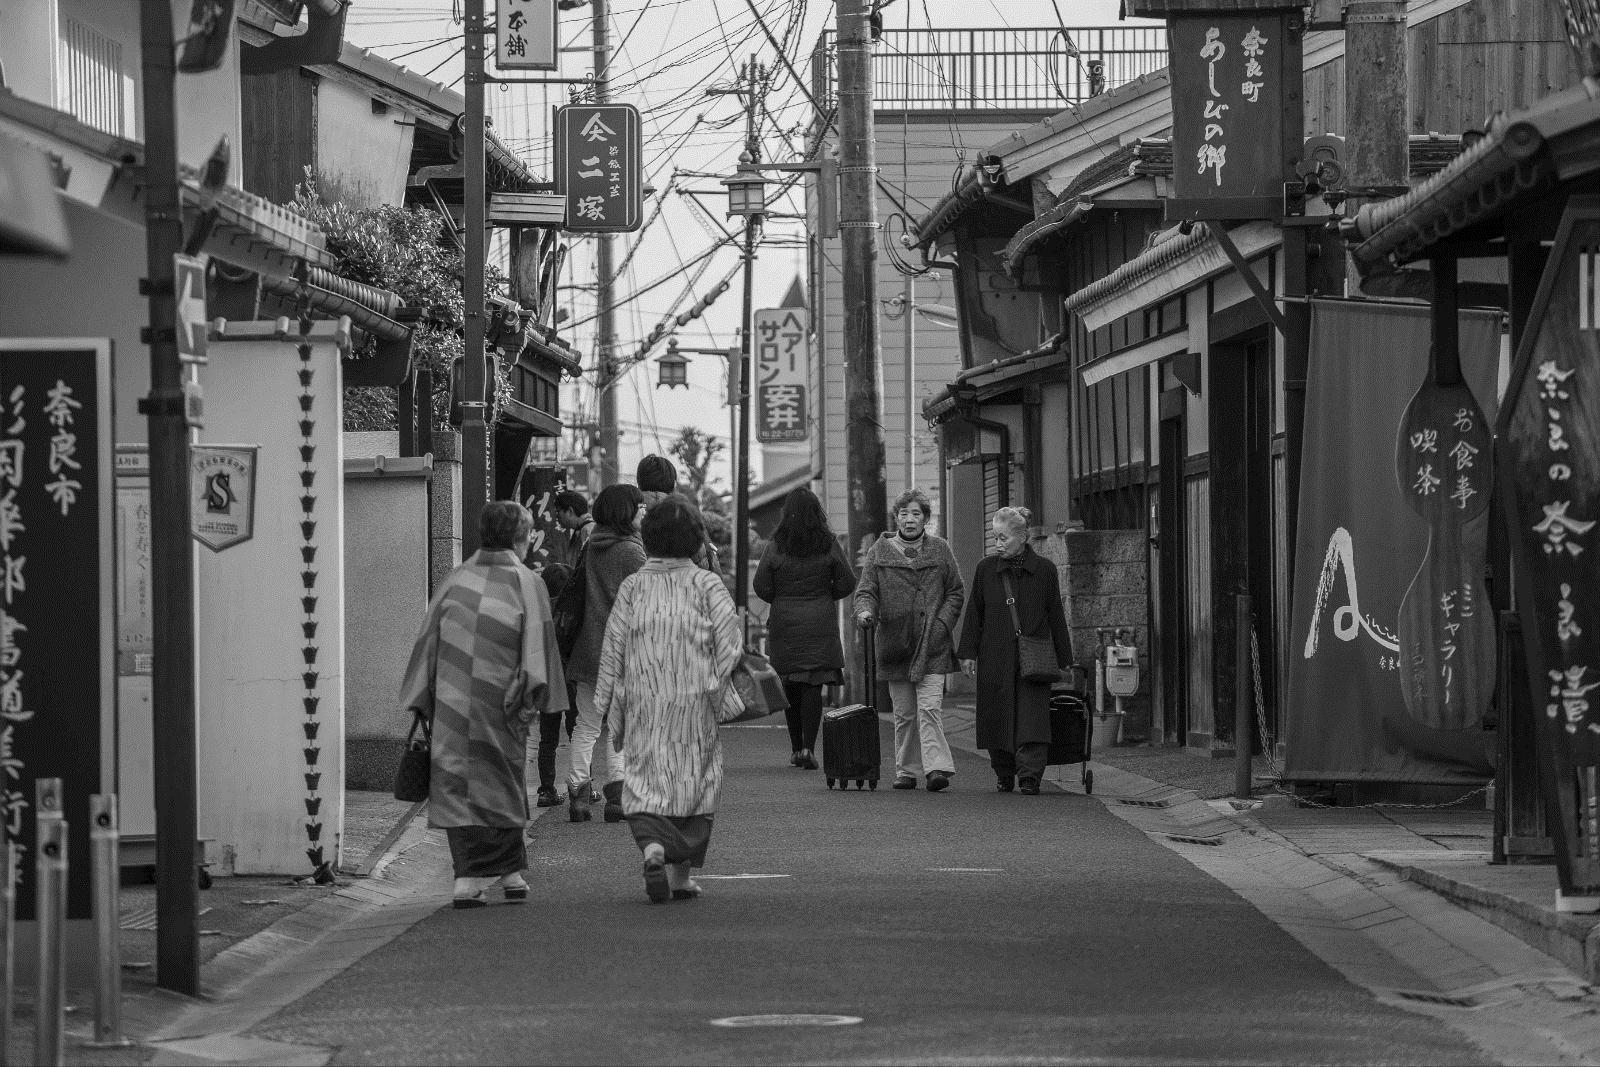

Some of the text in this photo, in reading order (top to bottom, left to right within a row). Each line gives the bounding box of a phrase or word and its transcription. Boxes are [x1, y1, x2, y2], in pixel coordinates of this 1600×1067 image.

[758, 320, 780, 385] サロン
[781, 311, 803, 372] ヘアー
[764, 385, 800, 429] 安井
[43, 379, 83, 517] 奈良市
[1410, 428, 1441, 496] 喫茶
[1449, 408, 1479, 510] お食事
[1460, 582, 1475, 618] ミニ
[1440, 589, 1461, 705] ギャラリー
